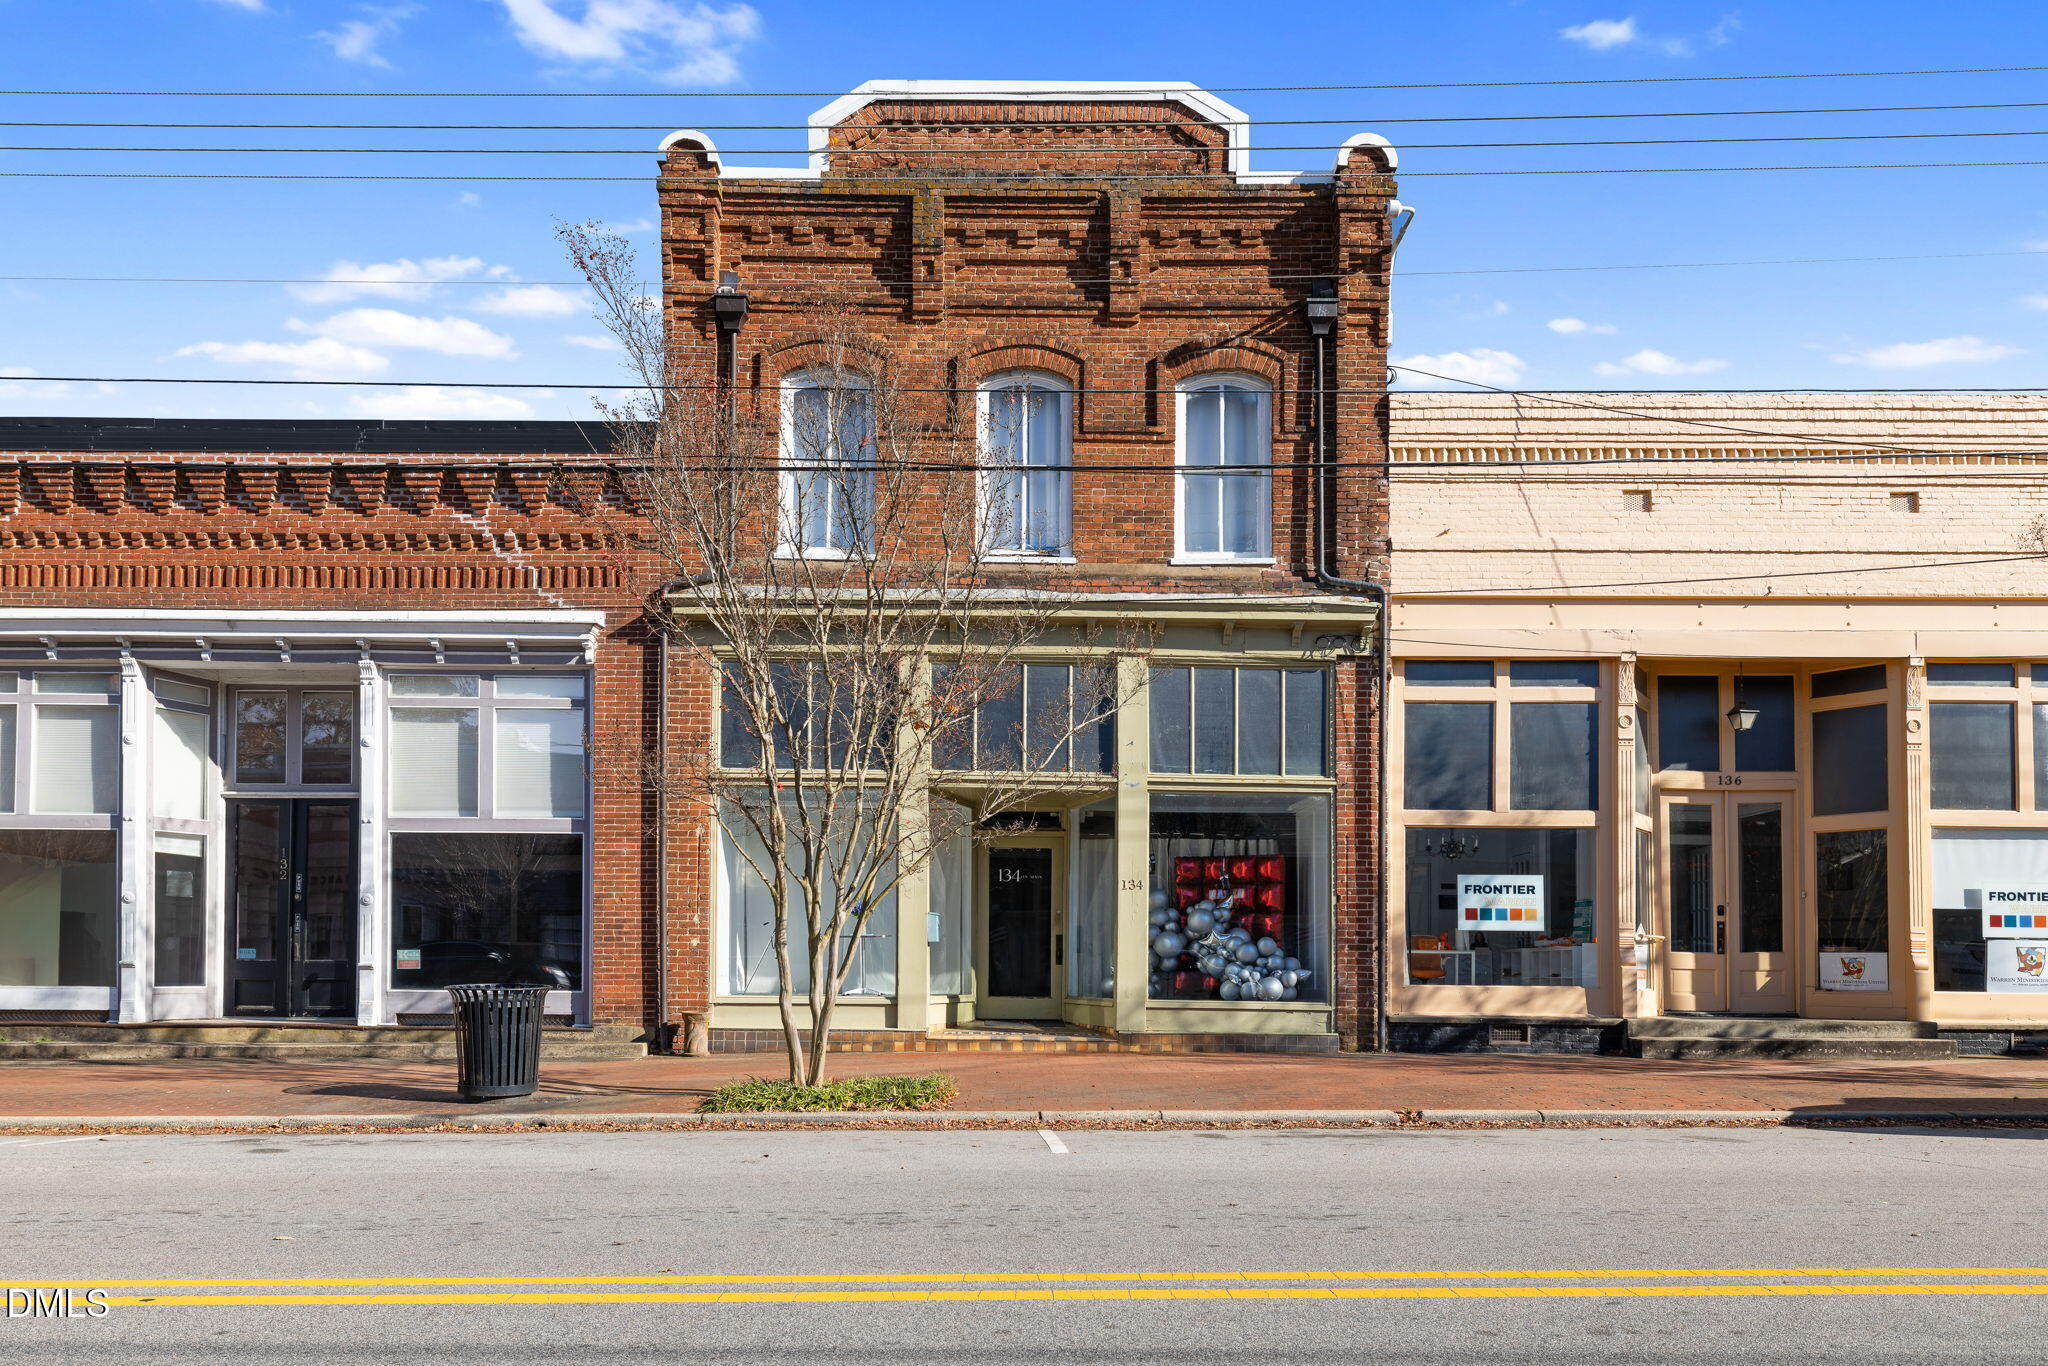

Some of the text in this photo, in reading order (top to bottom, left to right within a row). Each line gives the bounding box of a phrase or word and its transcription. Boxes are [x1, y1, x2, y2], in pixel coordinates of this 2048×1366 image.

[1718, 775, 1743, 786] 136
[279, 848, 288, 880] 132
[999, 868, 1020, 882] 134
[1121, 879, 1144, 891] 134
[1464, 884, 1536, 895] FRONTIER
